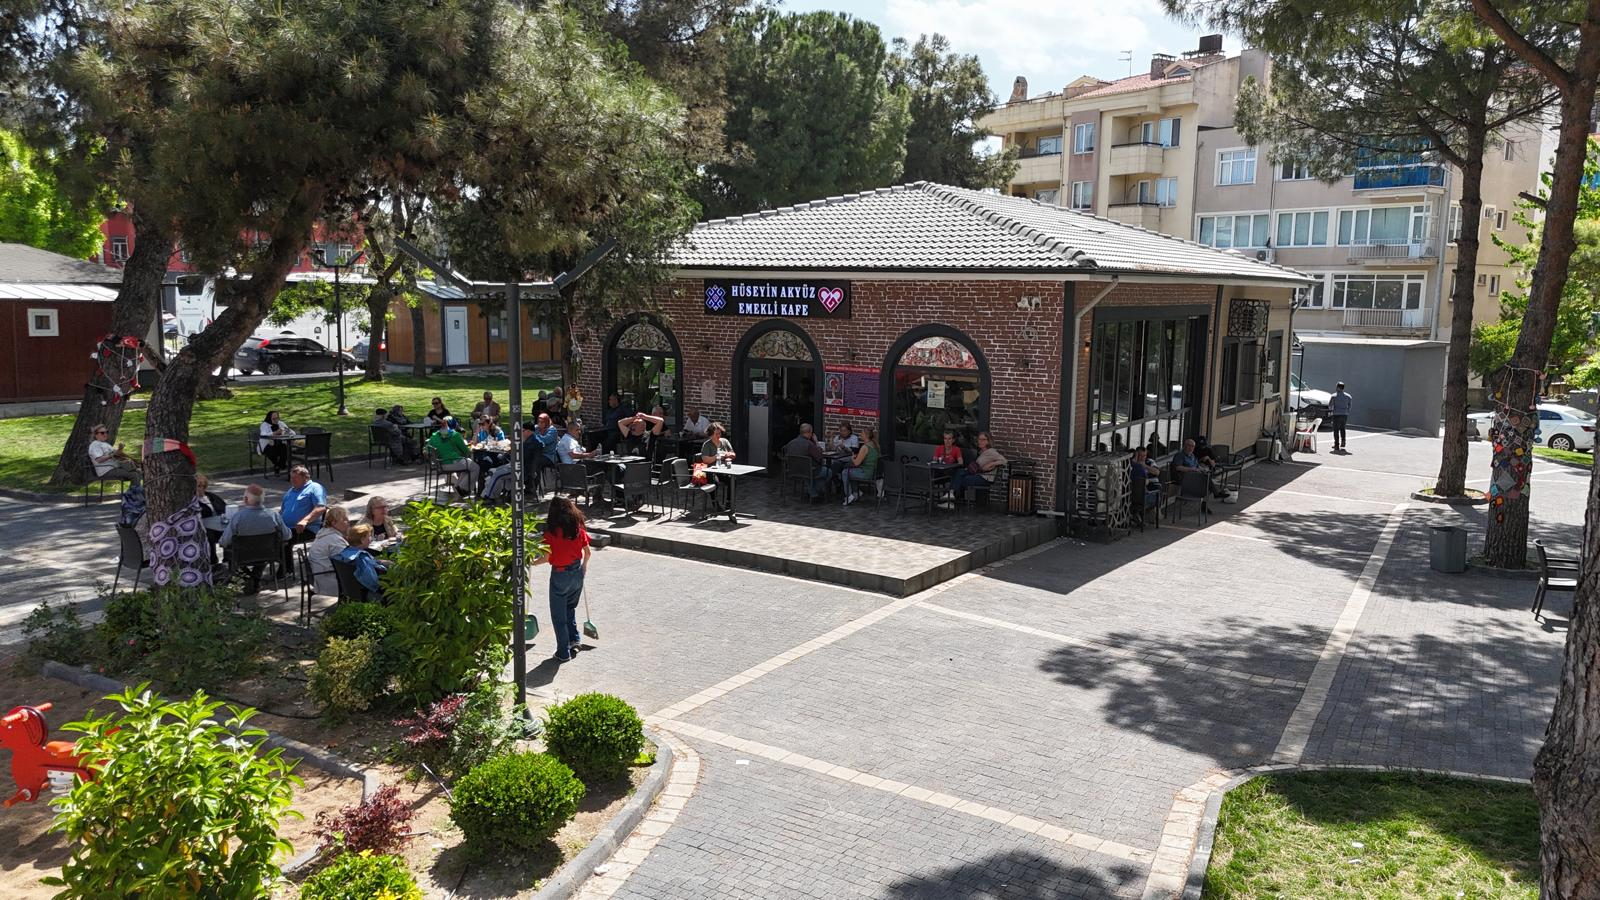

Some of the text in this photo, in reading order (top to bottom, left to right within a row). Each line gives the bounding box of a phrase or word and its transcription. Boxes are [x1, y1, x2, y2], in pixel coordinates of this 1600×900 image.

[731, 283, 816, 299] HÜSEYİN AKYÜZ
[738, 301, 809, 316] EMEKLİ KAFE
